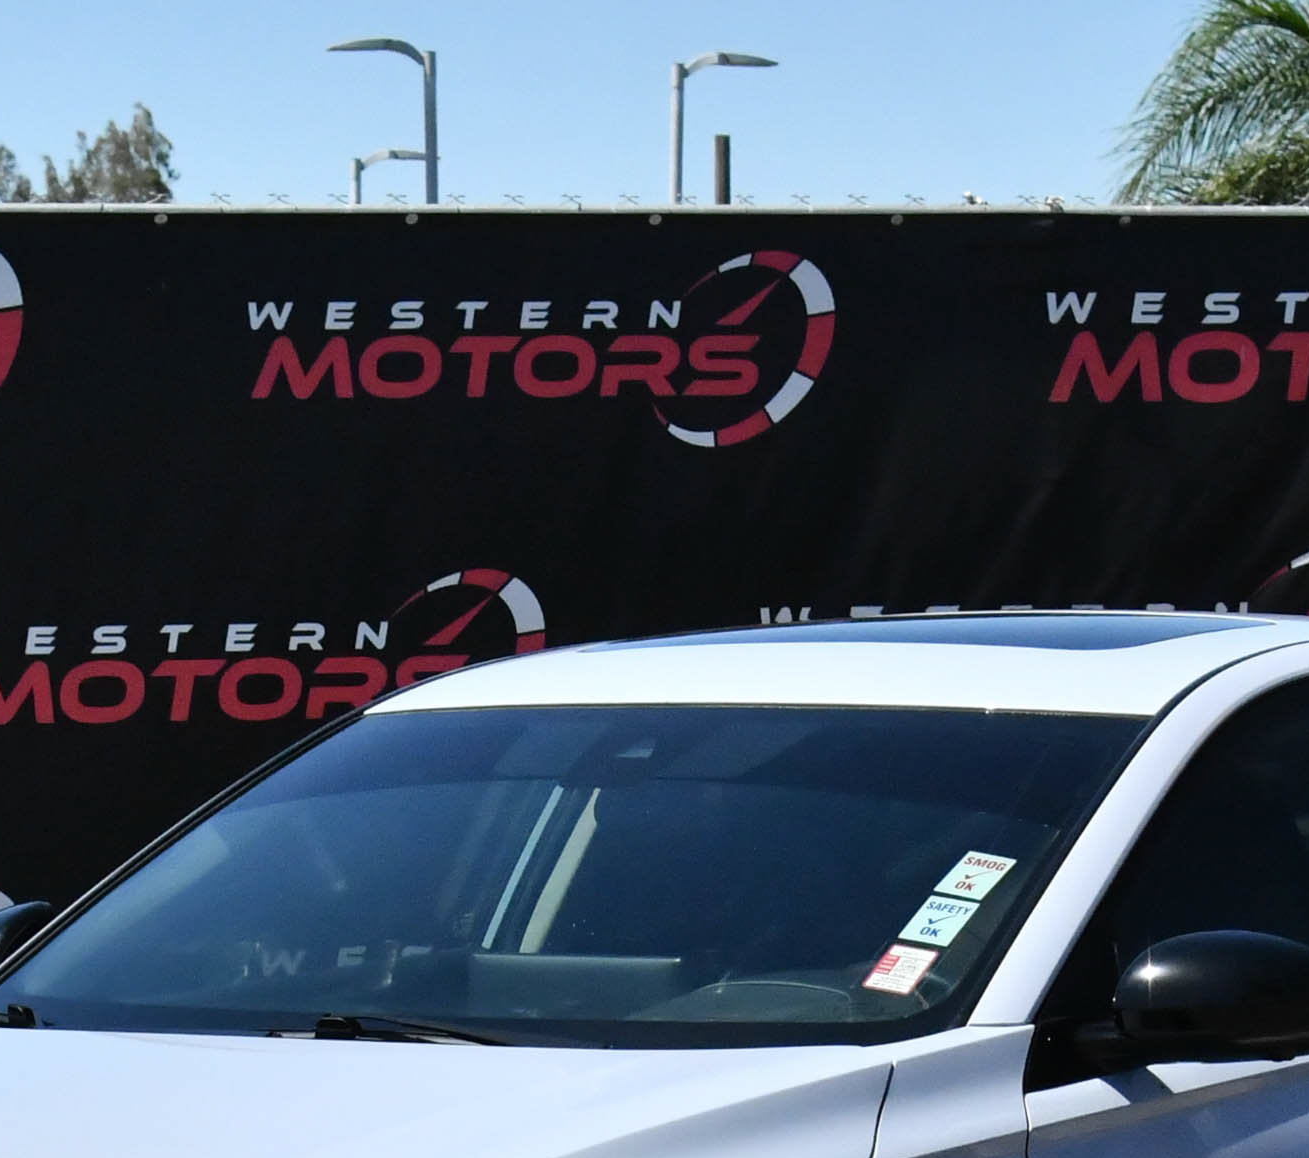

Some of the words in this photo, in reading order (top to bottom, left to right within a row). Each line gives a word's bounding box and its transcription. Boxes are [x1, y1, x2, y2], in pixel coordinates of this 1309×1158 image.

[247, 300, 682, 331] WESTERN
[252, 335, 761, 399] MOTORS
[963, 856, 1007, 872] SMOG
[954, 880, 977, 892] OK
[926, 901, 974, 916] SAFETY
[919, 926, 942, 938] OK
